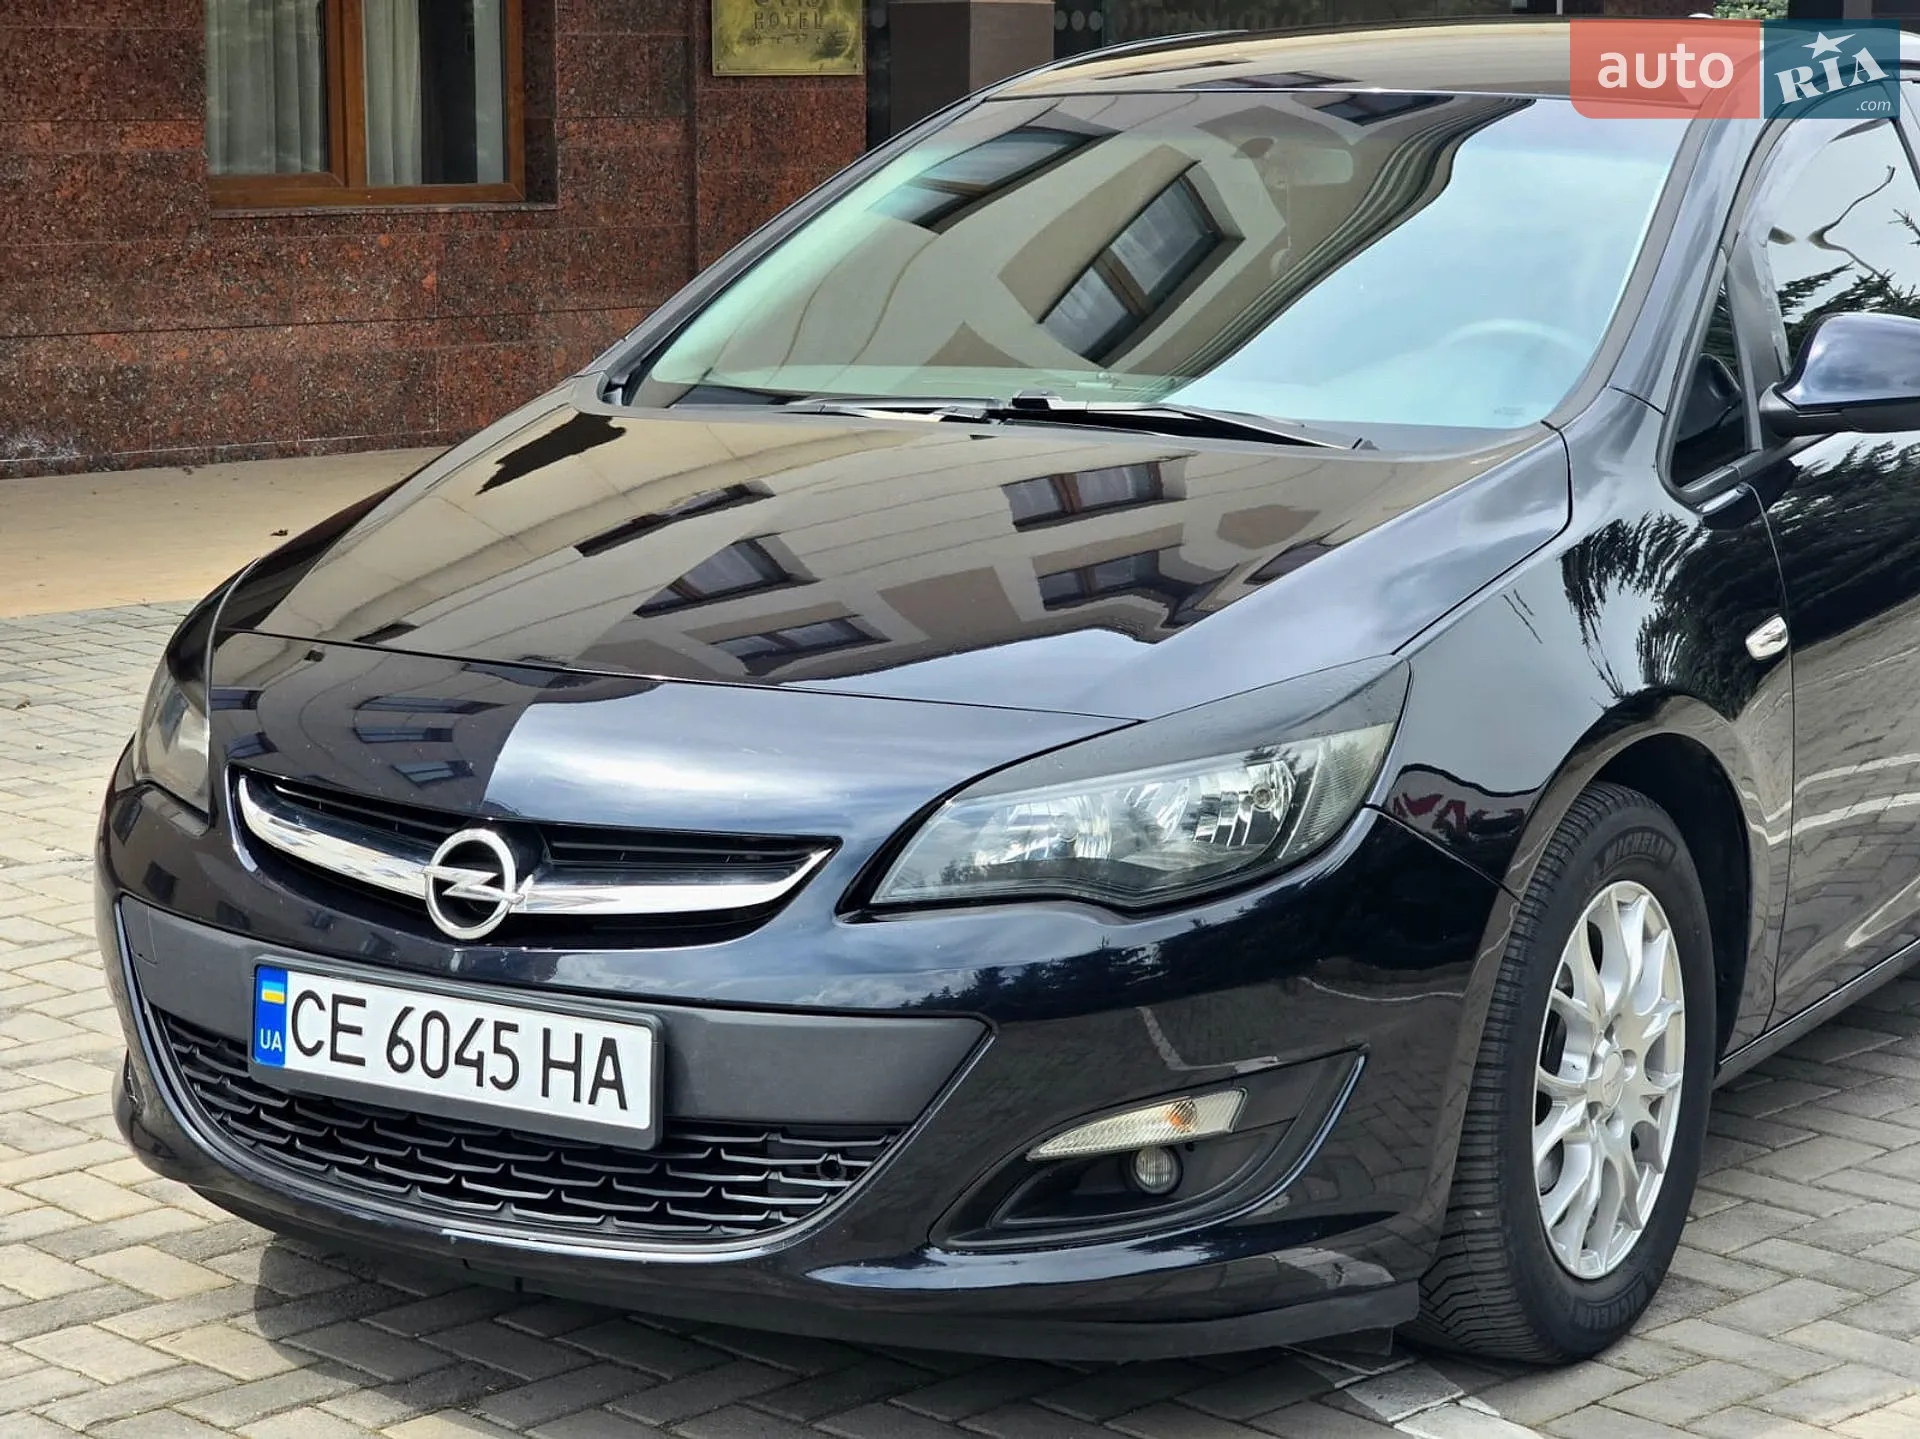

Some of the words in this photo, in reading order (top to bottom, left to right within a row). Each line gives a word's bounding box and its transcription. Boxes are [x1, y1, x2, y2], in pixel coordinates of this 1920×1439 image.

[754, 10, 825, 30] HOTEL
[260, 1028, 282, 1053] UA
[291, 989, 367, 1067] CE
[386, 1006, 519, 1092] 6045
[541, 1027, 628, 1111] HA
